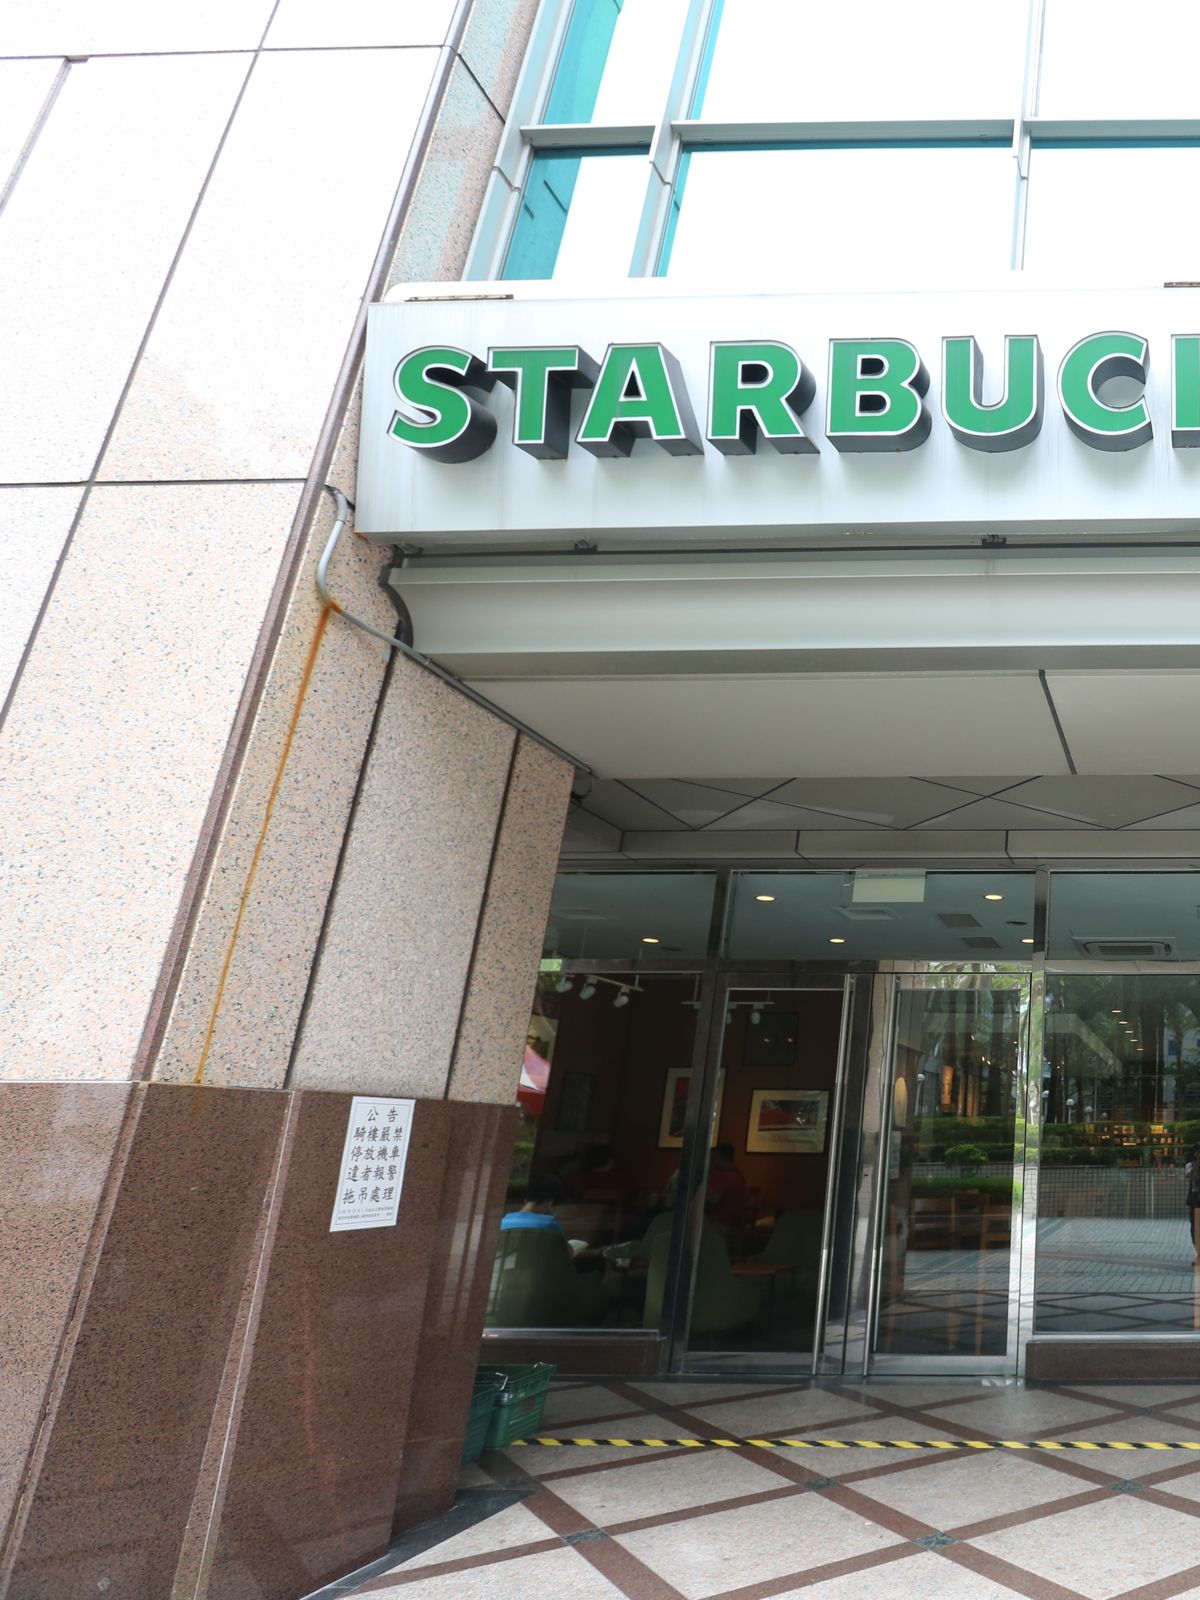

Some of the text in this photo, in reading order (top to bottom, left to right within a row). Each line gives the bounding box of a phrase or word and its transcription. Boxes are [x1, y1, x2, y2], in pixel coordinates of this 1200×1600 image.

[367, 1106, 398, 1122] 公告
[354, 1127, 403, 1142] 騎樓嚴禁
[351, 1146, 400, 1162] 停放機車
[347, 1166, 397, 1182] 違者報警
[343, 1186, 394, 1205] 拖吊處理
